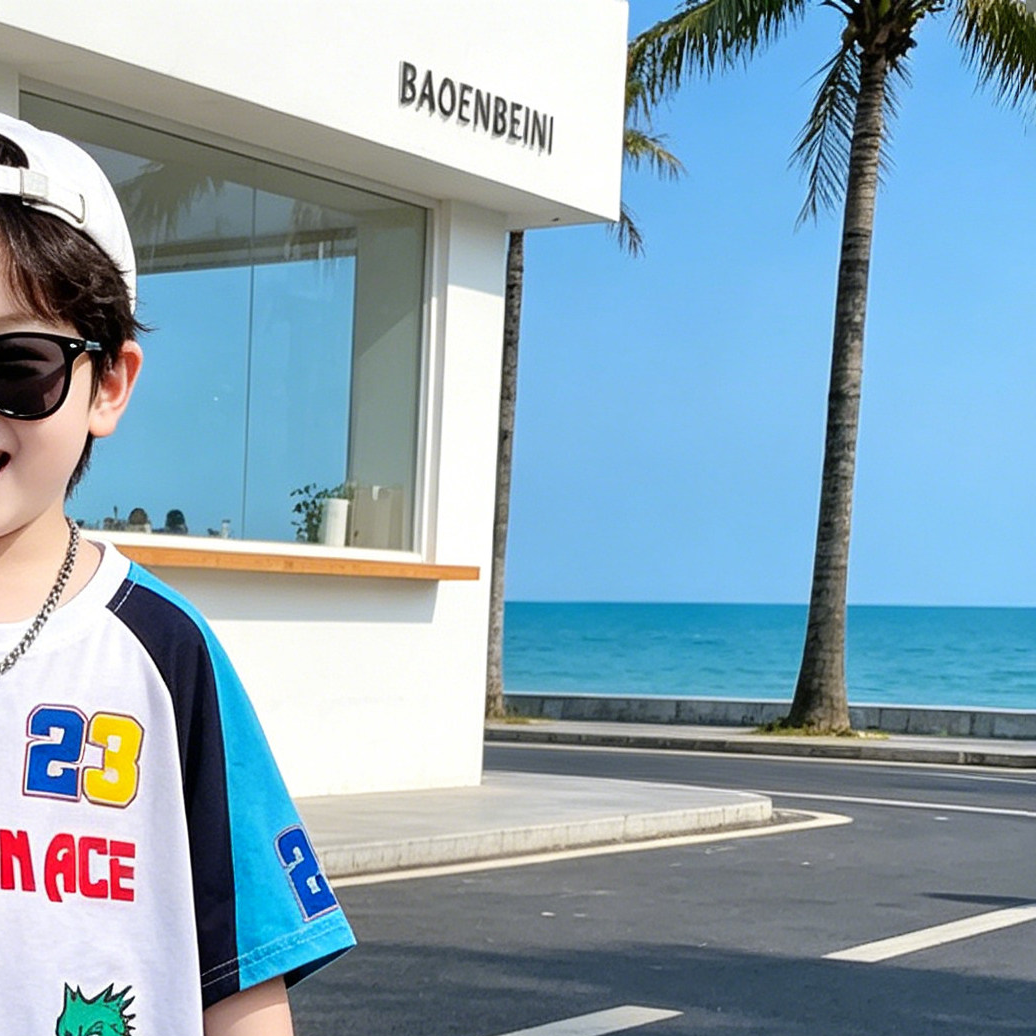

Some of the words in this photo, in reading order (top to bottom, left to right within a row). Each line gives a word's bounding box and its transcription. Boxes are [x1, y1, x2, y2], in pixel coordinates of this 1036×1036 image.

[399, 60, 554, 156] BAOENBEINI
[23, 702, 145, 809] 23
[44, 832, 136, 902] ACE
